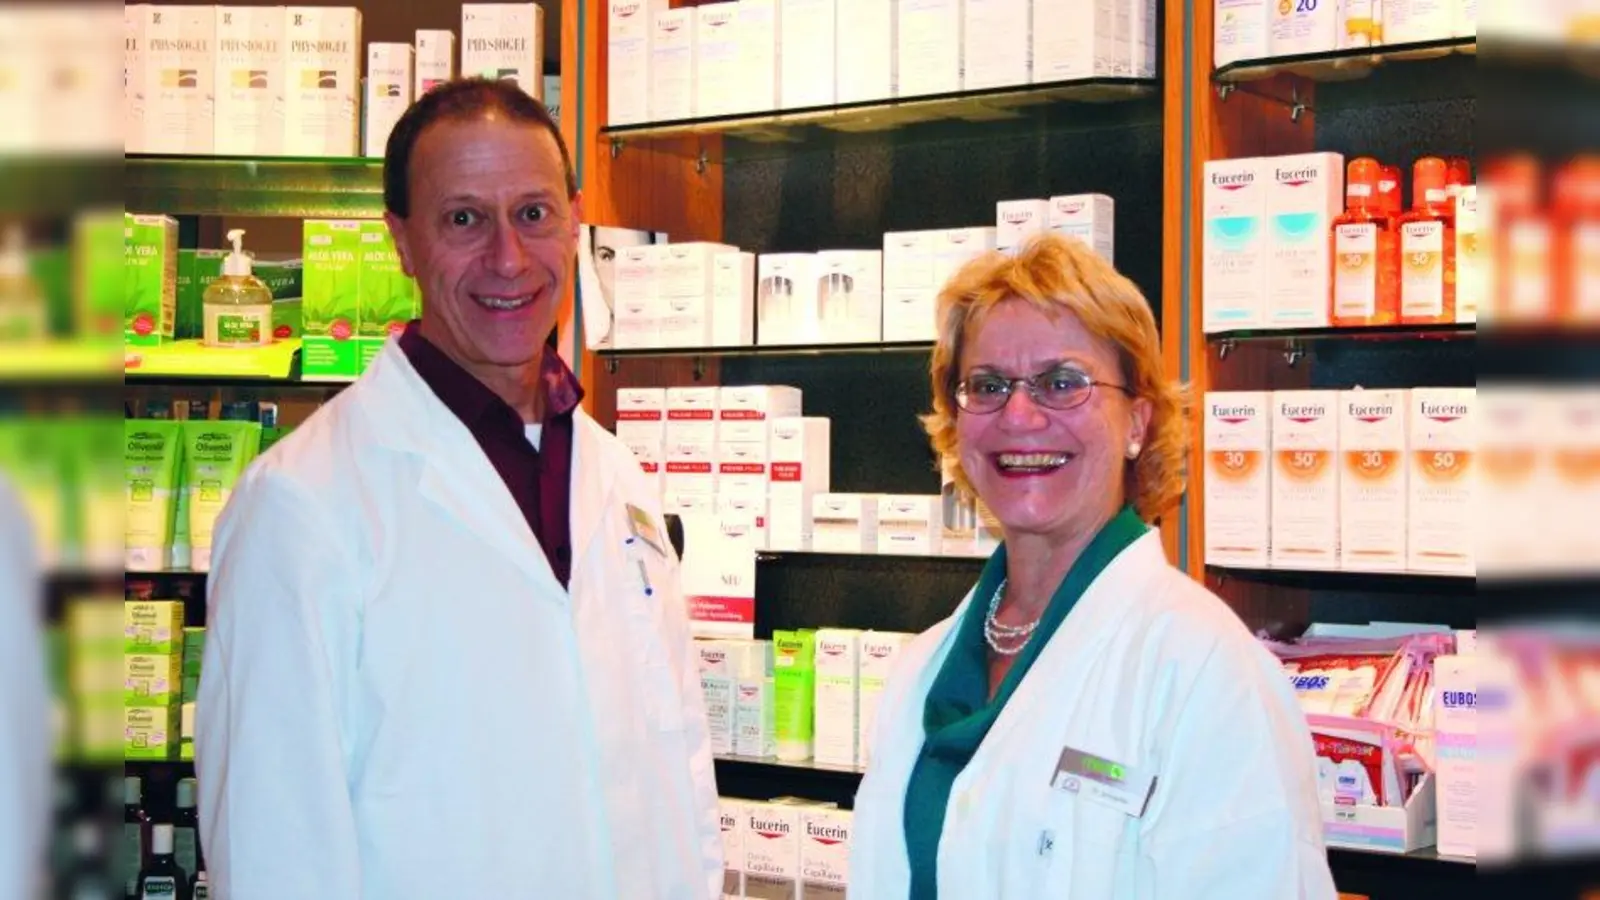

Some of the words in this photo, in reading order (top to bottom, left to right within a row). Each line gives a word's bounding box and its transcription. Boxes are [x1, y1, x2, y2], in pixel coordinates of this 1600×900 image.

[291, 40, 349, 54] PHYSIOGEL
[467, 37, 527, 52] PHYSIOGEL
[1211, 171, 1255, 185] Eucerin
[1275, 166, 1318, 181] Eucerin
[1212, 404, 1256, 417] Eucerin
[1281, 403, 1325, 416] Eucerin
[1349, 403, 1393, 416] Eucerin
[1421, 401, 1468, 415] Eucerin
[1224, 452, 1244, 467] 30
[1362, 452, 1382, 467] 30
[1433, 452, 1456, 467] 50
[1289, 676, 1330, 690] UBOS
[720, 813, 736, 827] rin
[750, 815, 790, 833] Eucerin
[806, 821, 848, 840] Eucerin
